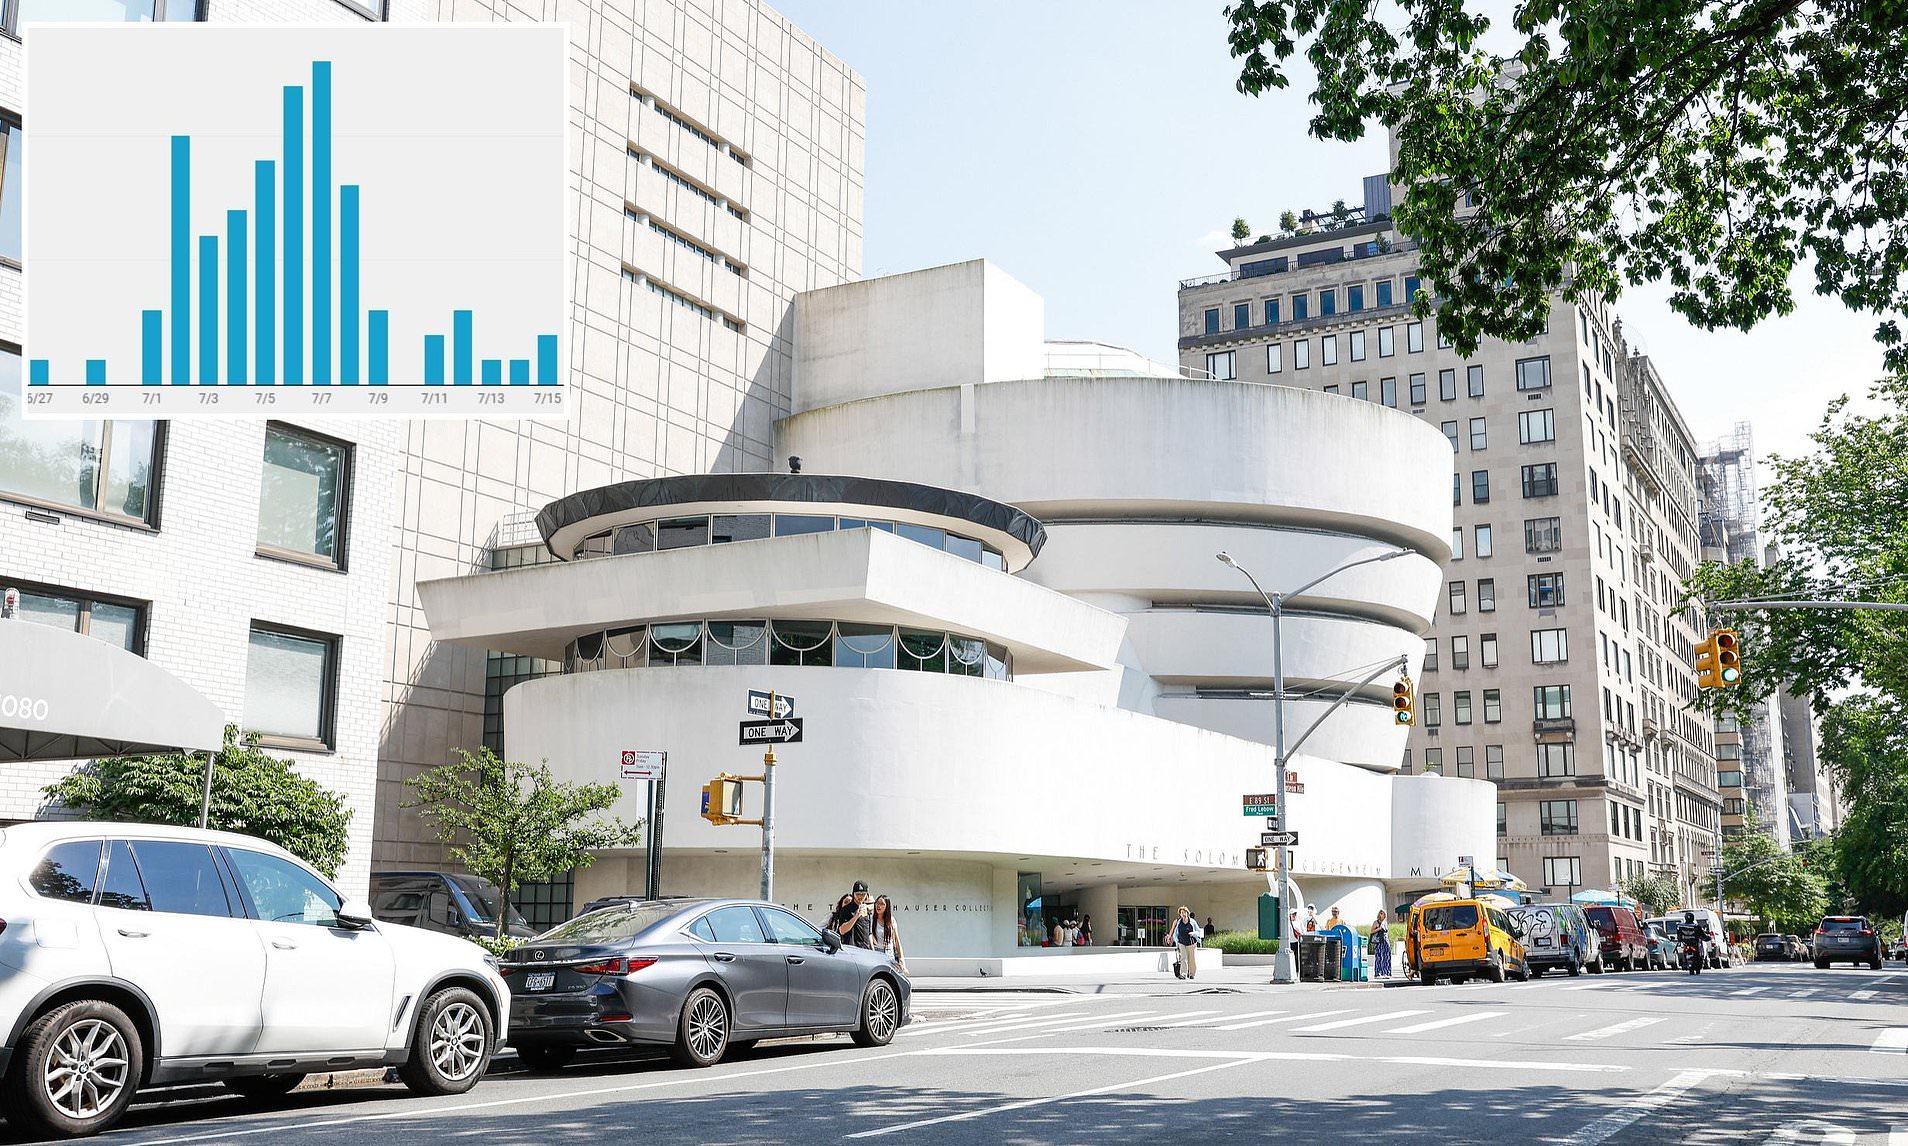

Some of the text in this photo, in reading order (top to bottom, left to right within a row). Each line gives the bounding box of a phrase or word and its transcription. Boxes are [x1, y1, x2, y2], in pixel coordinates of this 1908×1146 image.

[0, 694, 49, 720] 080
[754, 698, 788, 713] ONE WAY
[748, 725, 794, 738] ONE WAY
[1254, 796, 1262, 804] 89
[1126, 843, 1158, 860] THE
[1303, 859, 1381, 876] GUGGENHEIM
